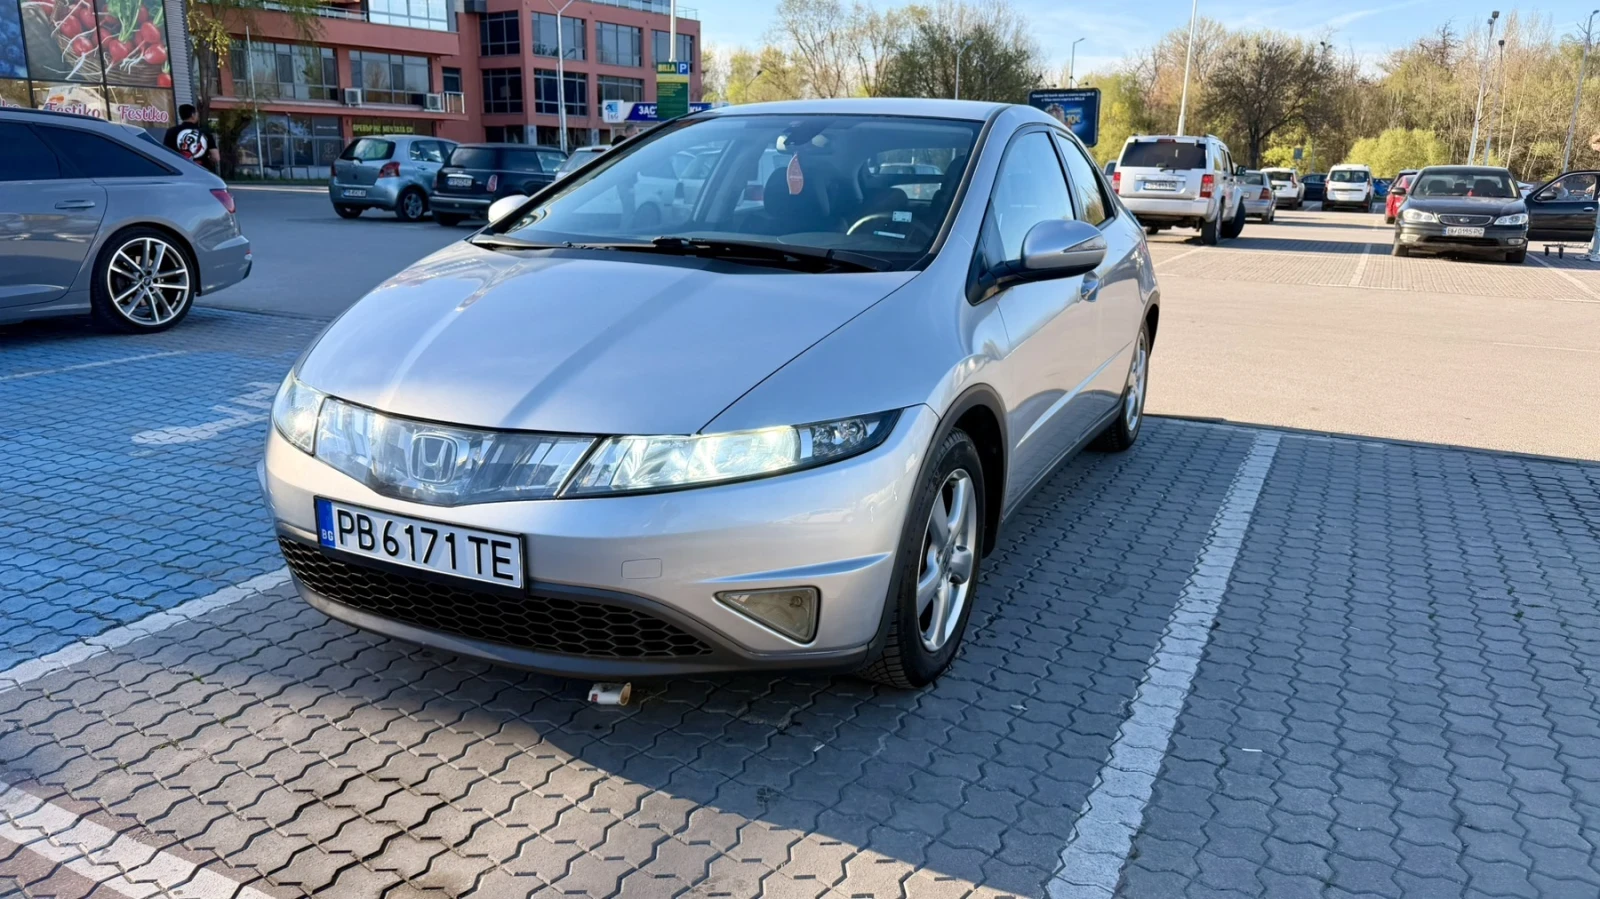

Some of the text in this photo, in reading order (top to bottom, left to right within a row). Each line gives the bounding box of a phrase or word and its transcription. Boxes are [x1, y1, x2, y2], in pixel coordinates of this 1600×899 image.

[658, 64, 675, 72] BILLA
[679, 63, 687, 73] P
[118, 105, 168, 122] Festiko
[321, 529, 334, 541] BG
[337, 509, 514, 581] PB 6171 TE
